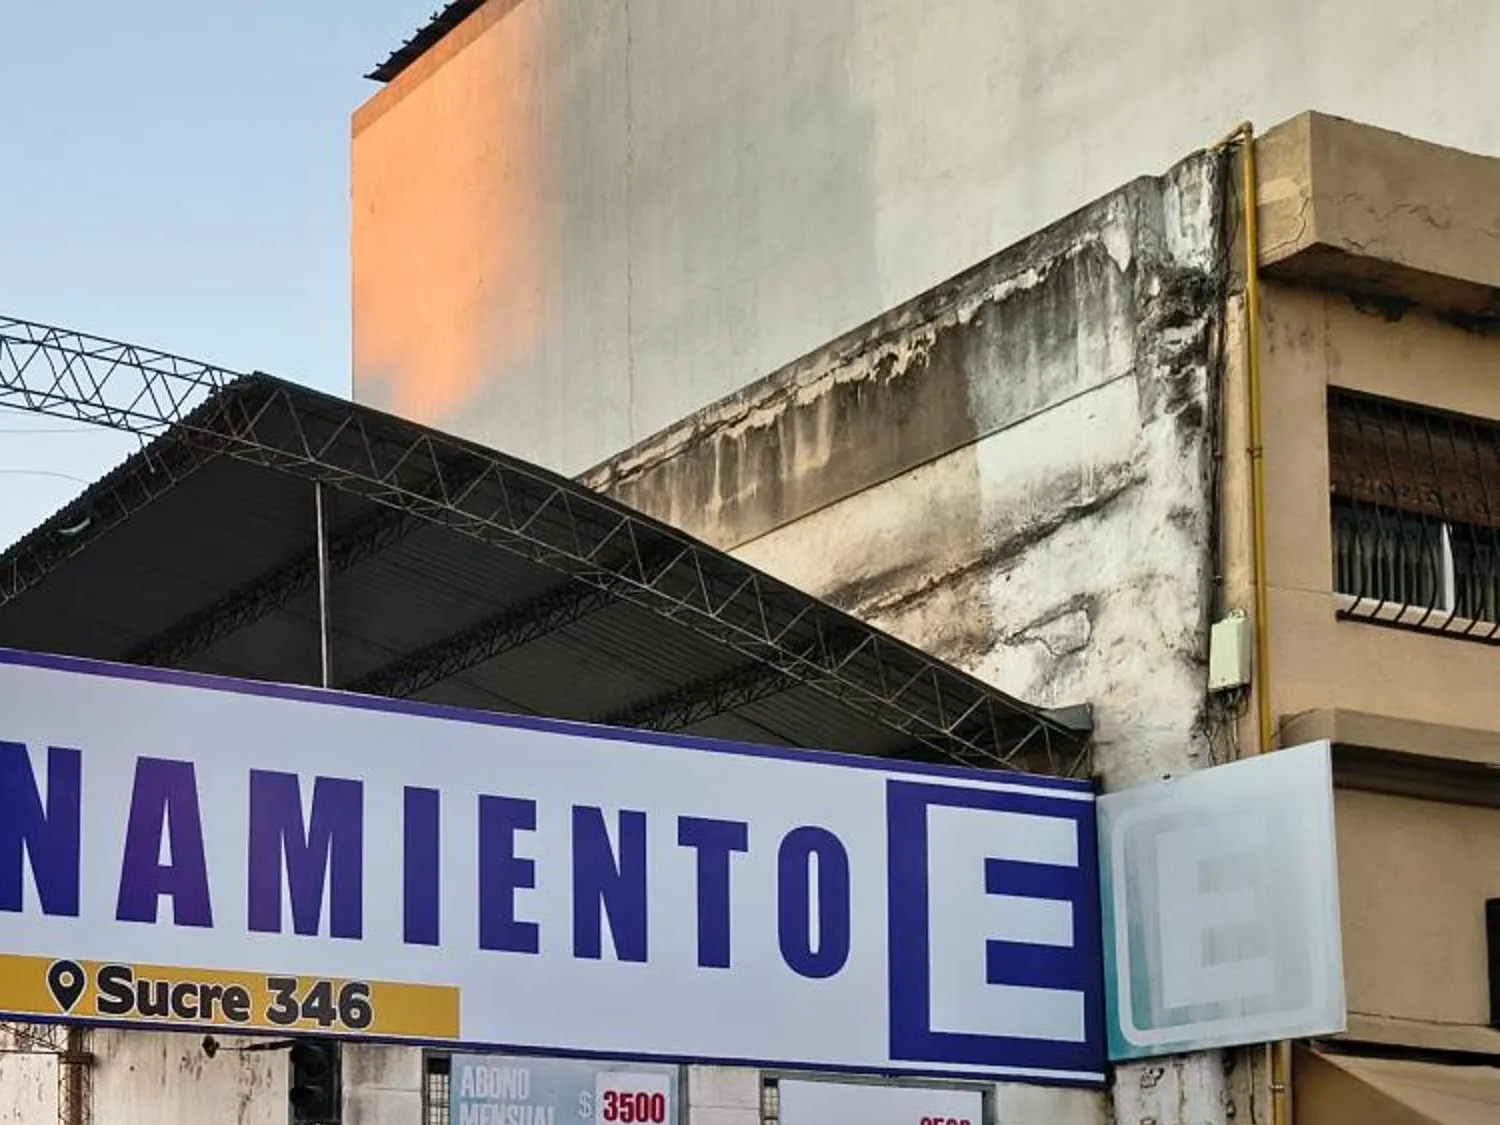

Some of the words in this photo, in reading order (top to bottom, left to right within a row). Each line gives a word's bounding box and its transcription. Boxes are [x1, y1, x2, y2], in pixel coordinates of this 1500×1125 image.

[926, 804, 1086, 1042] E
[96, 965, 252, 1023] Sucre
[265, 976, 375, 1030] 346
[460, 1064, 531, 1100] ABONO
[579, 1090, 593, 1120] $
[602, 1090, 665, 1125] 3500
